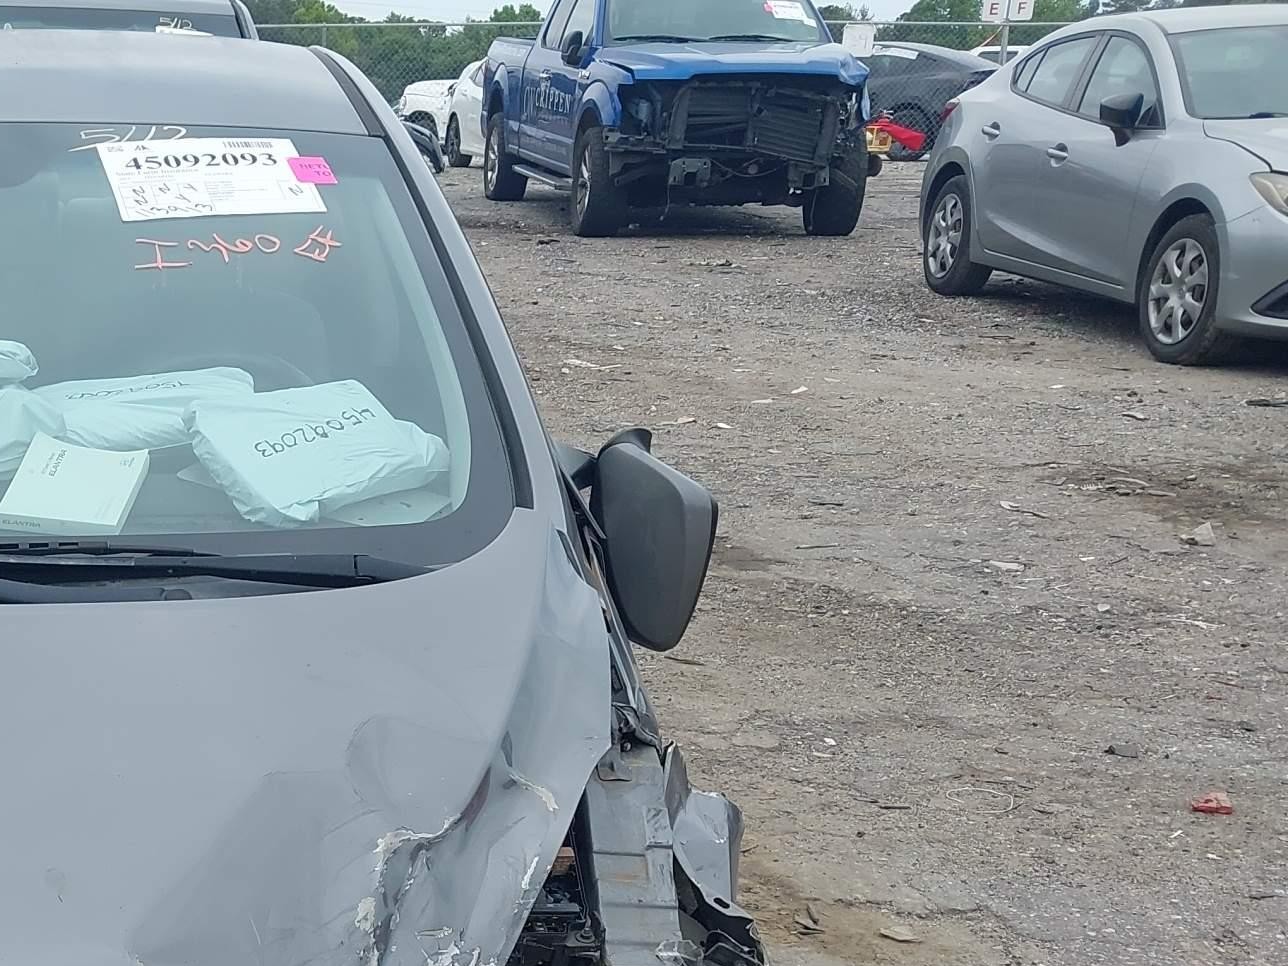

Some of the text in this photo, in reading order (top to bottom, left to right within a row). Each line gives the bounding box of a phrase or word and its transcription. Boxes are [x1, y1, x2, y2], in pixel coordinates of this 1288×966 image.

[989, 2, 1000, 15] E
[1017, 1, 1028, 14] F
[125, 152, 278, 170] 45092093
[254, 407, 377, 458] 45092093
[48, 449, 68, 477] ELANTRA
[2, 519, 41, 528] ELANTRA
